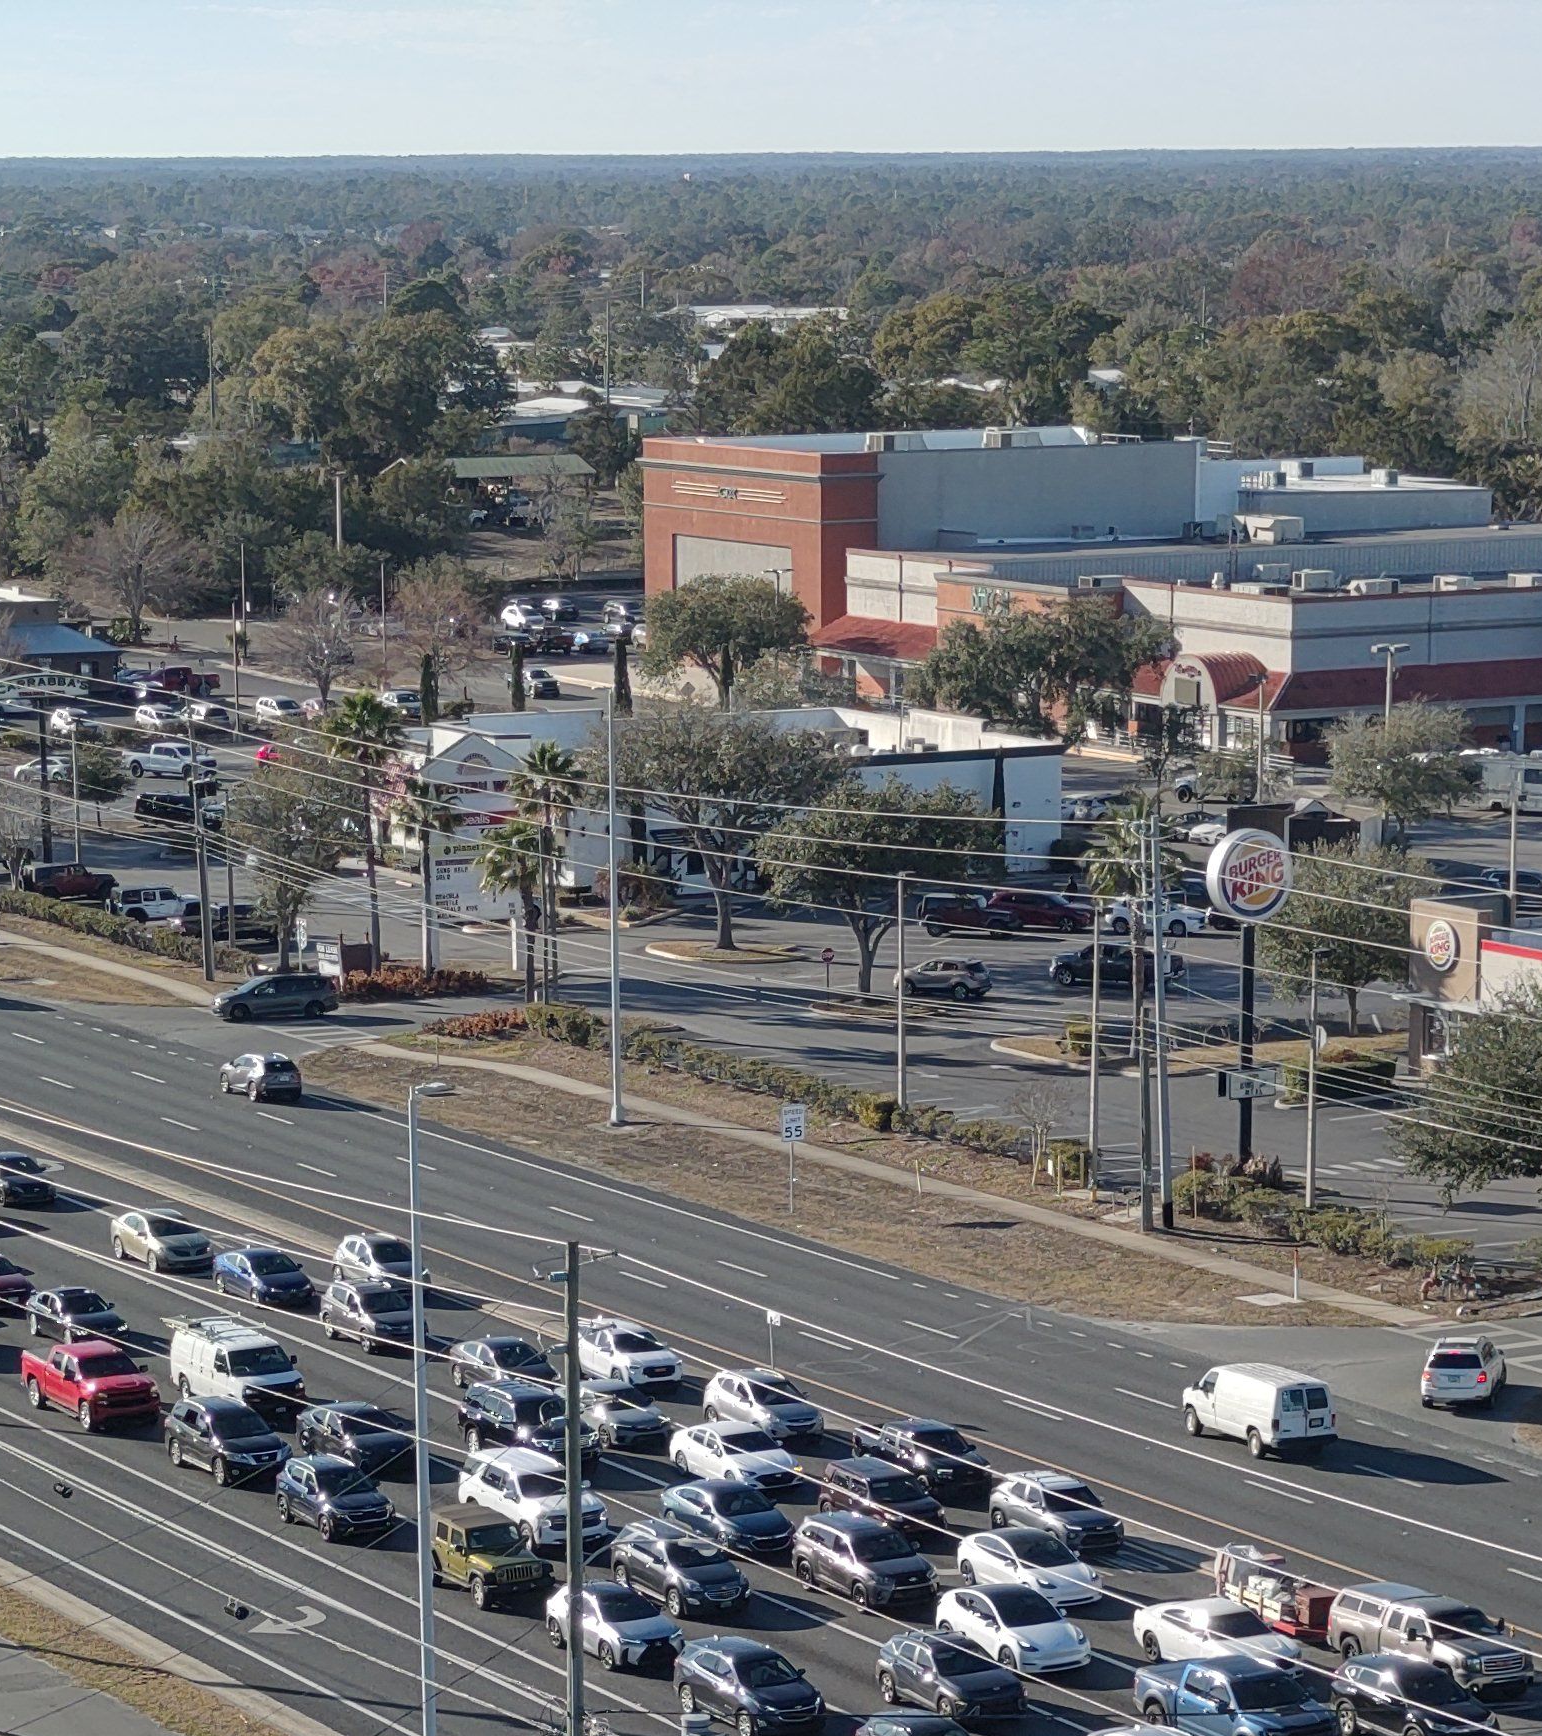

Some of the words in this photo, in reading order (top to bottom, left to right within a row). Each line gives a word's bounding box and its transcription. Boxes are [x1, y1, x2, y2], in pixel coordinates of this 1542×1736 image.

[1229, 848, 1282, 882] BURGER
[1231, 861, 1284, 905] KING
[785, 1126, 802, 1138] 55
